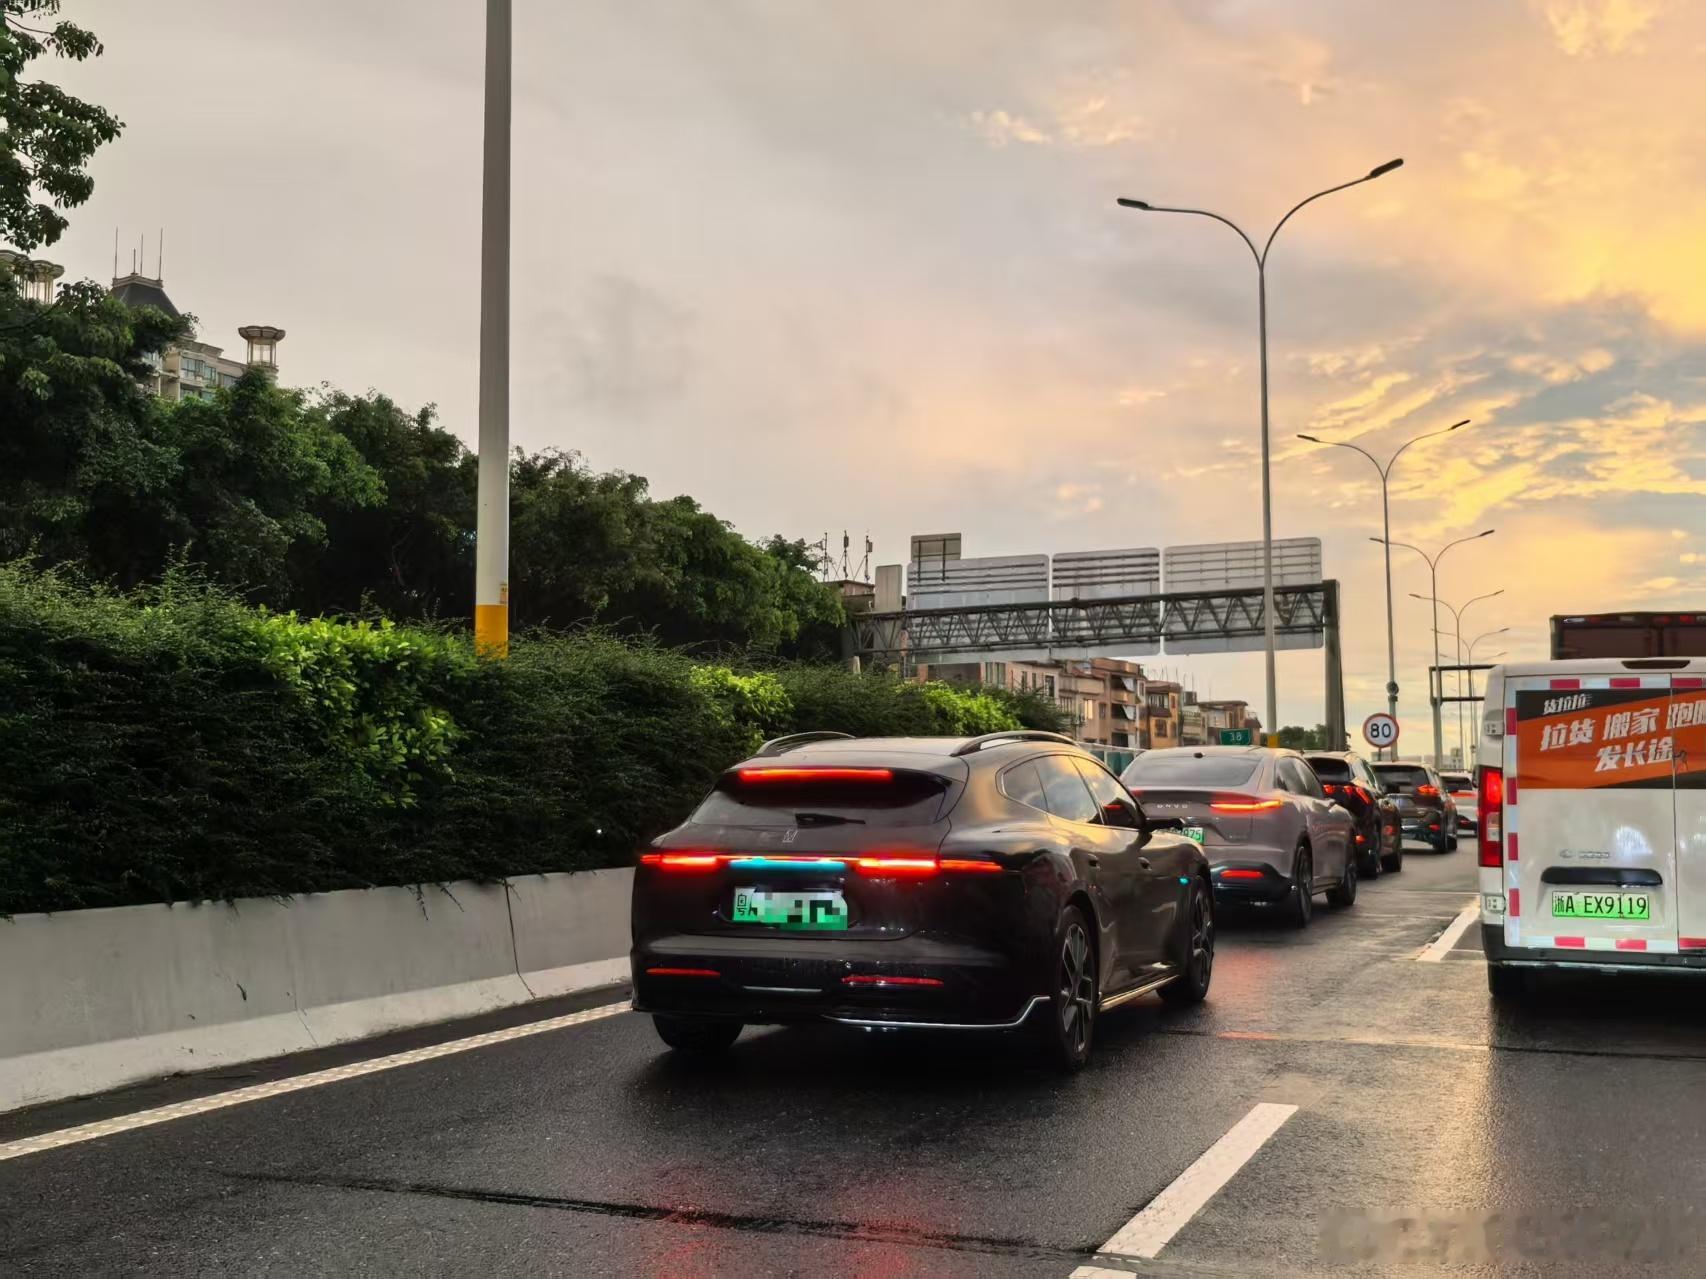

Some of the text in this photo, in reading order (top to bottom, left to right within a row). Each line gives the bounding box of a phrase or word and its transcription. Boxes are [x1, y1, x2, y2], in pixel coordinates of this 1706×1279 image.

[1543, 693, 1587, 714] 货拉拉
[1370, 723, 1392, 738] 80
[1539, 718, 1595, 751] 拉货
[1602, 708, 1660, 741] 搬家
[1595, 736, 1673, 772] 发长途
[1584, 895, 1647, 915] EX9119
